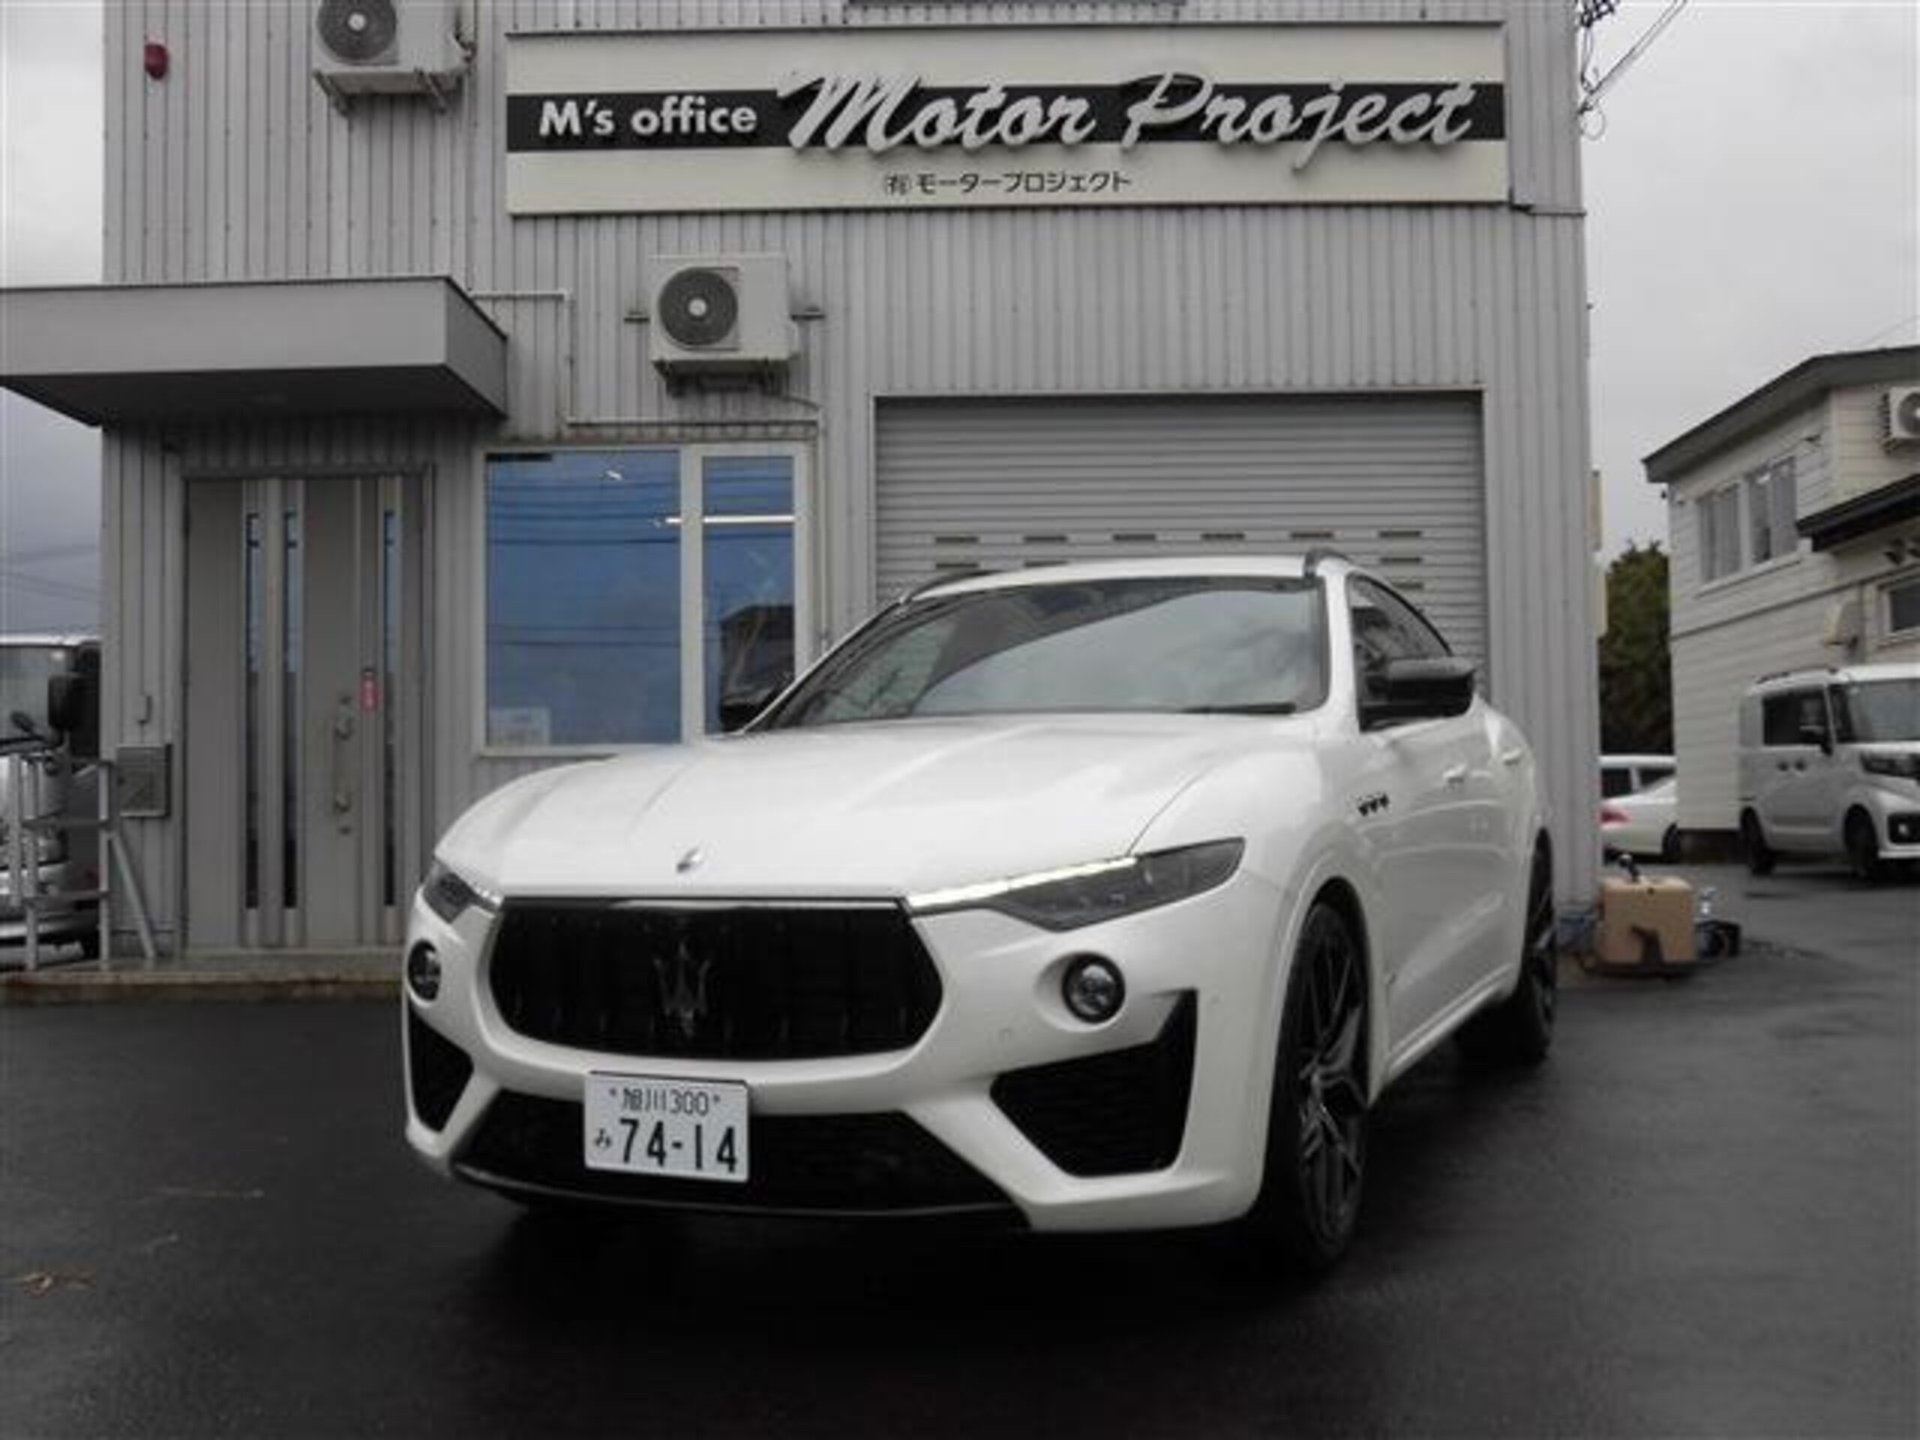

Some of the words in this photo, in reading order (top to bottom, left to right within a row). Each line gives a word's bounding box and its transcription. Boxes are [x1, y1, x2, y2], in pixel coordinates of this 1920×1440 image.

[539, 100, 615, 137] M's
[630, 95, 758, 135] office
[776, 72, 1097, 153] Motor
[1118, 72, 1477, 176] Project
[619, 1117, 738, 1174] 74-14
